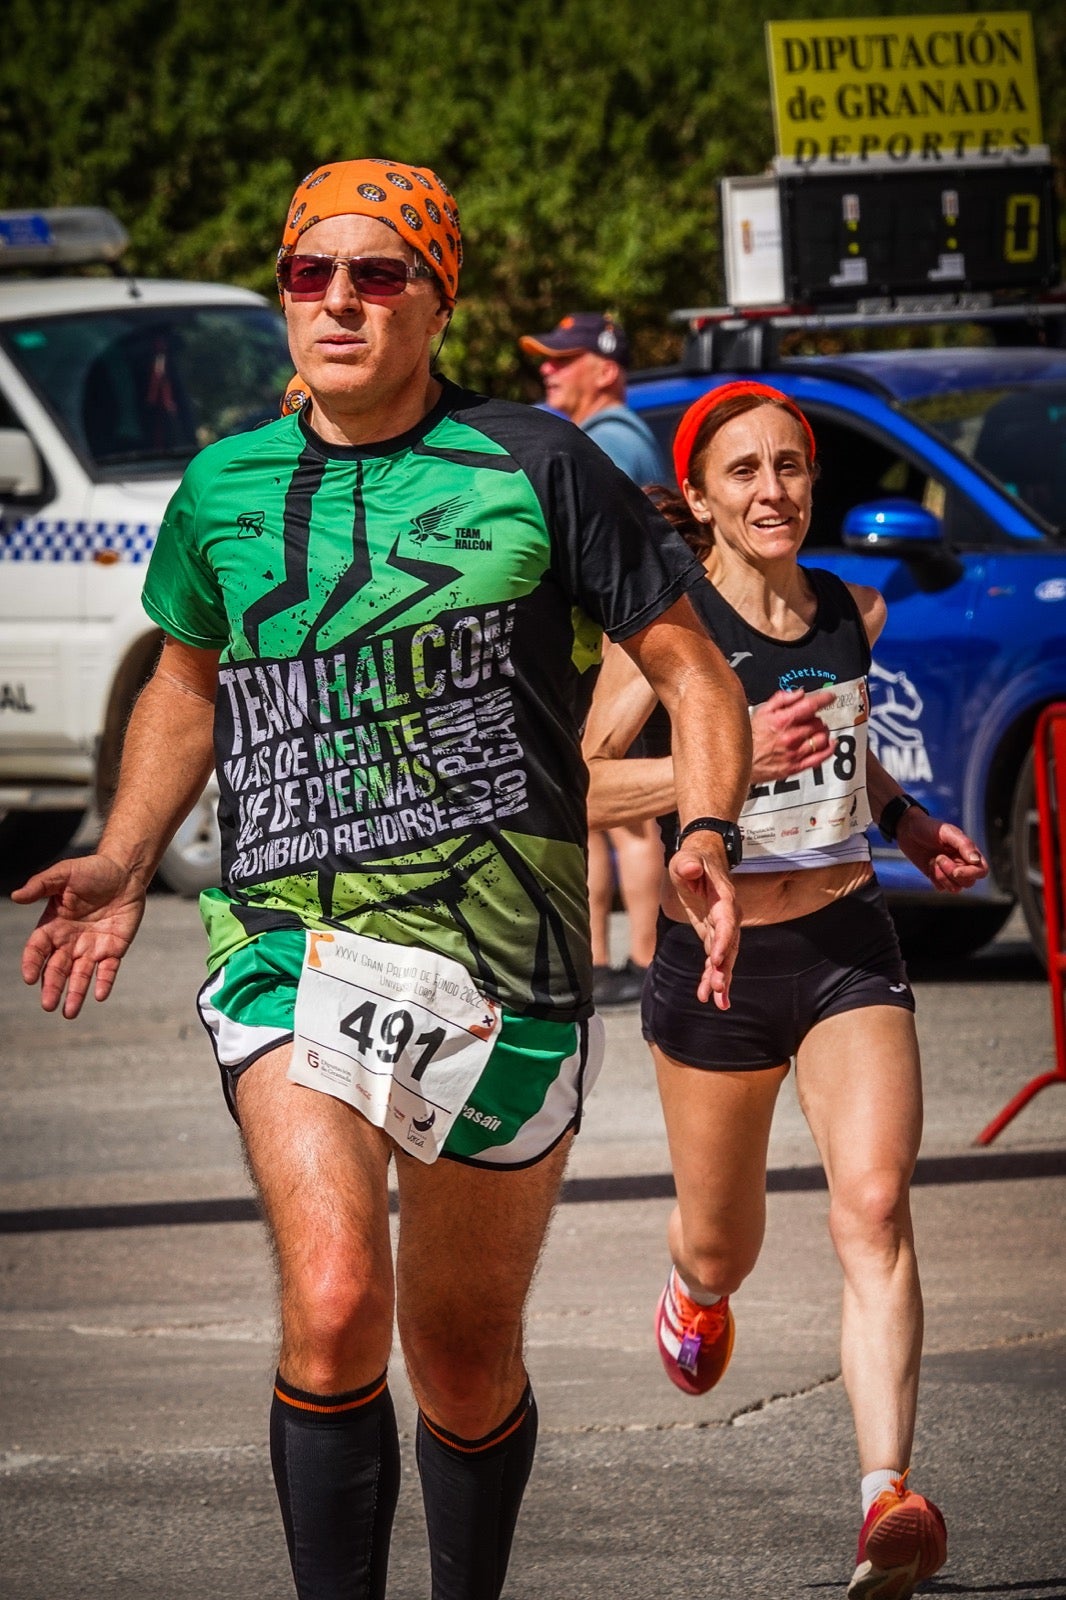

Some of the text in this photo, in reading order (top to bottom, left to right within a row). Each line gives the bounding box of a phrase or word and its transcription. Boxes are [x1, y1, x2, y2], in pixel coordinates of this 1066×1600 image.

[782, 19, 1023, 73] DIPUTACIÓN
[786, 77, 1027, 122] de GRANADA
[793, 127, 1031, 166] DEPORTES
[455, 527, 480, 539] TEAM
[781, 667, 836, 684] Atletismo
[218, 660, 309, 755] TEAM
[274, 737, 309, 780] DE
[314, 711, 428, 772] MENTE
[425, 698, 495, 830] NO PAIN
[474, 686, 530, 818] NO GAIN
[268, 780, 301, 833] DE
[333, 797, 451, 856] RENDIRSE
[339, 1000, 447, 1082] 491
